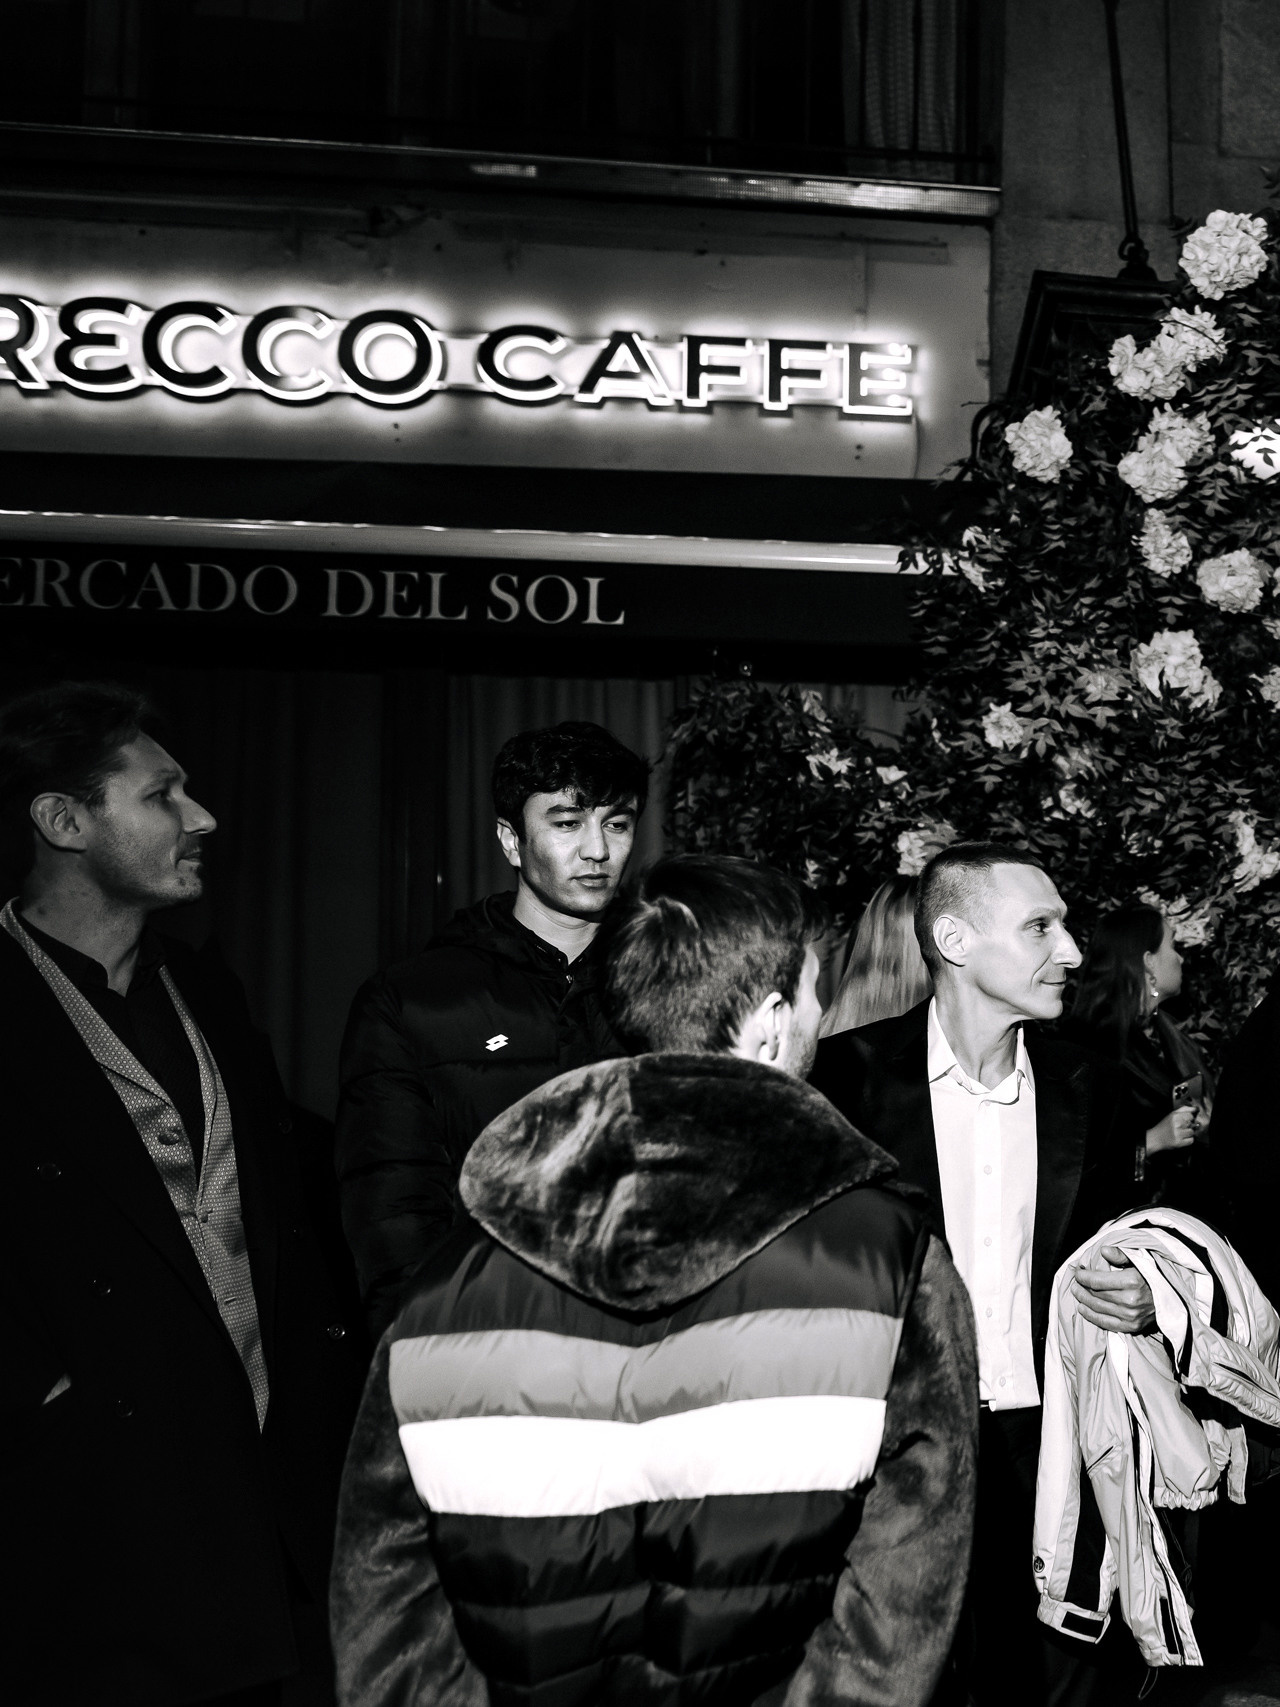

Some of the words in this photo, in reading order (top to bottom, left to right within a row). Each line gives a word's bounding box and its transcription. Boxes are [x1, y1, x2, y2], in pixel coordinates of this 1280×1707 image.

[476, 324, 913, 416] CAFFE
[322, 568, 468, 620] DEL
[486, 573, 625, 625] SOL
